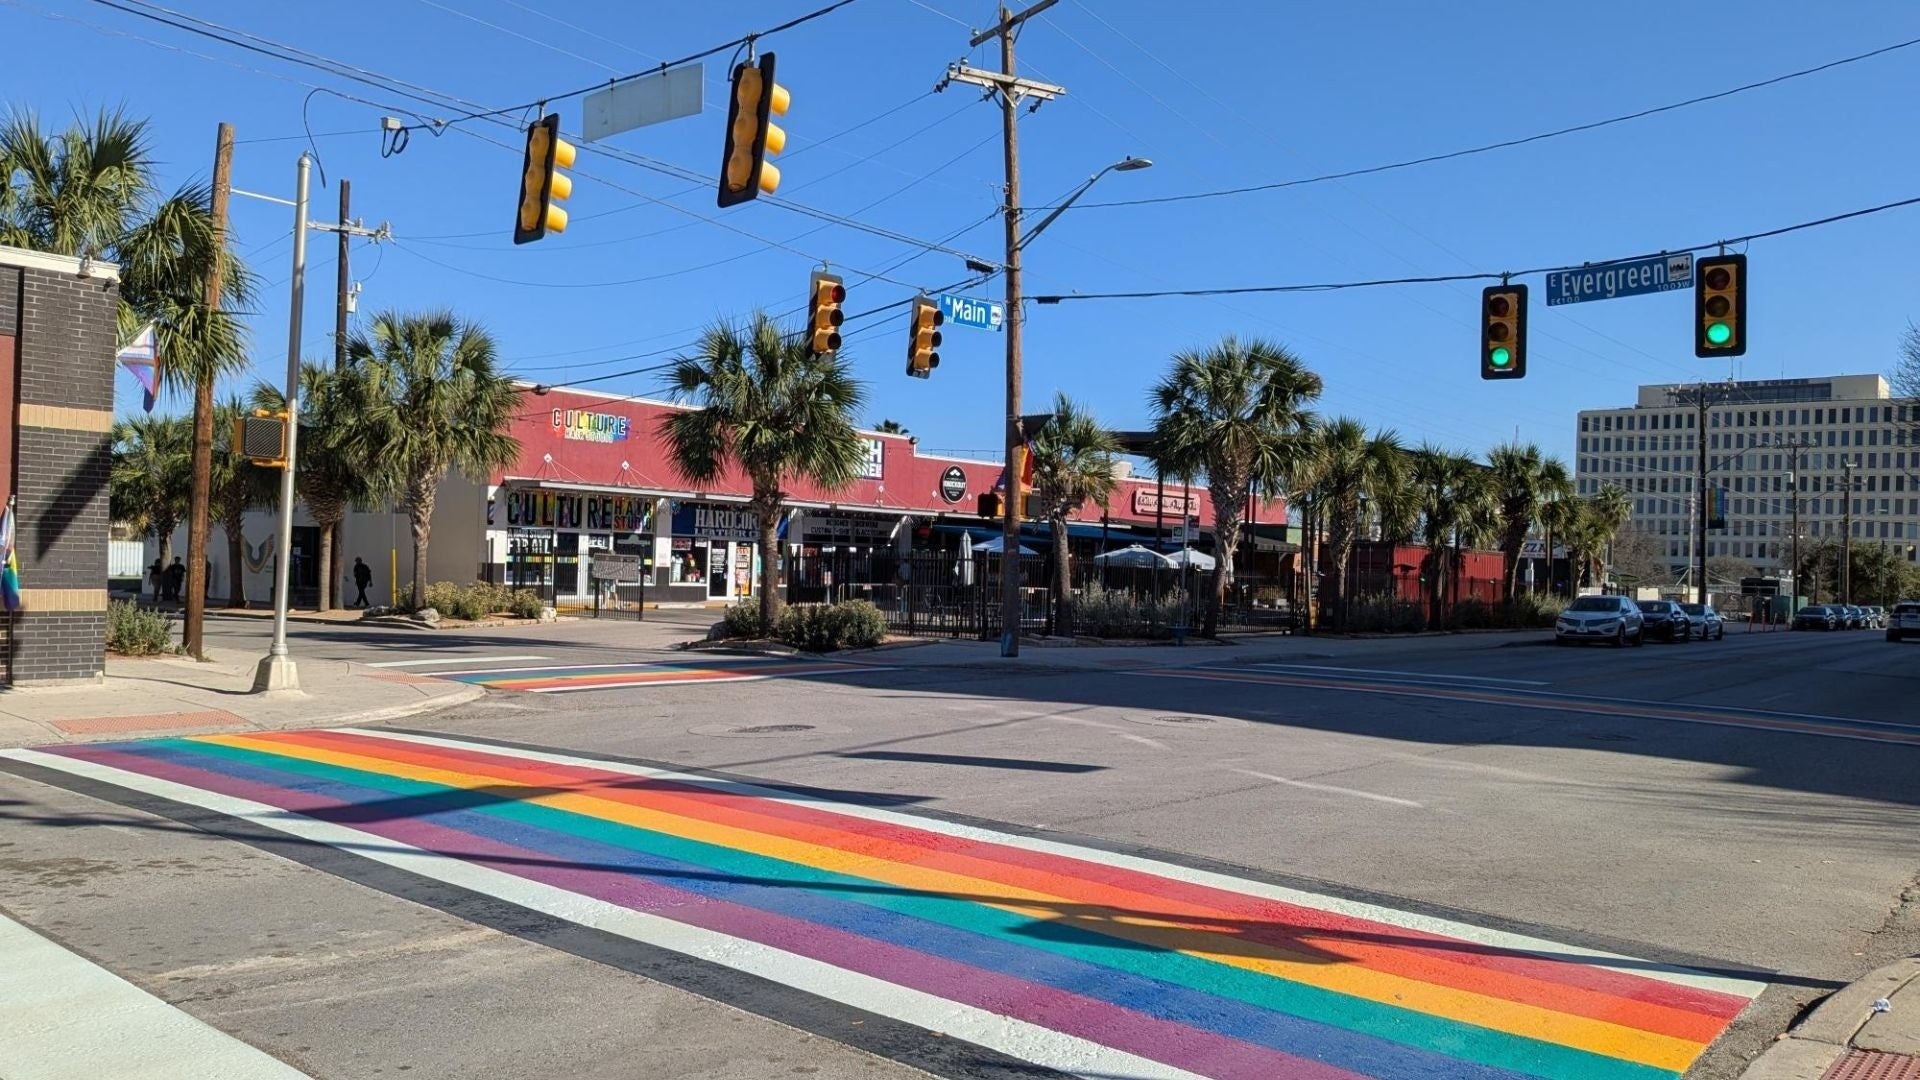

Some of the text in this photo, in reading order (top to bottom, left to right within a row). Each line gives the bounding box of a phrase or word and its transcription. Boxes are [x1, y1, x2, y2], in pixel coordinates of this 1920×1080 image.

[1550, 274, 1556, 287] E
[1561, 262, 1665, 298] Evergreen
[945, 296, 951, 305] N
[952, 298, 986, 324] Main
[553, 408, 626, 435] CULTURE
[508, 492, 652, 528] CULTURE HAIR
[695, 508, 760, 529] HARDCOR
[694, 528, 745, 537] LEATHER
